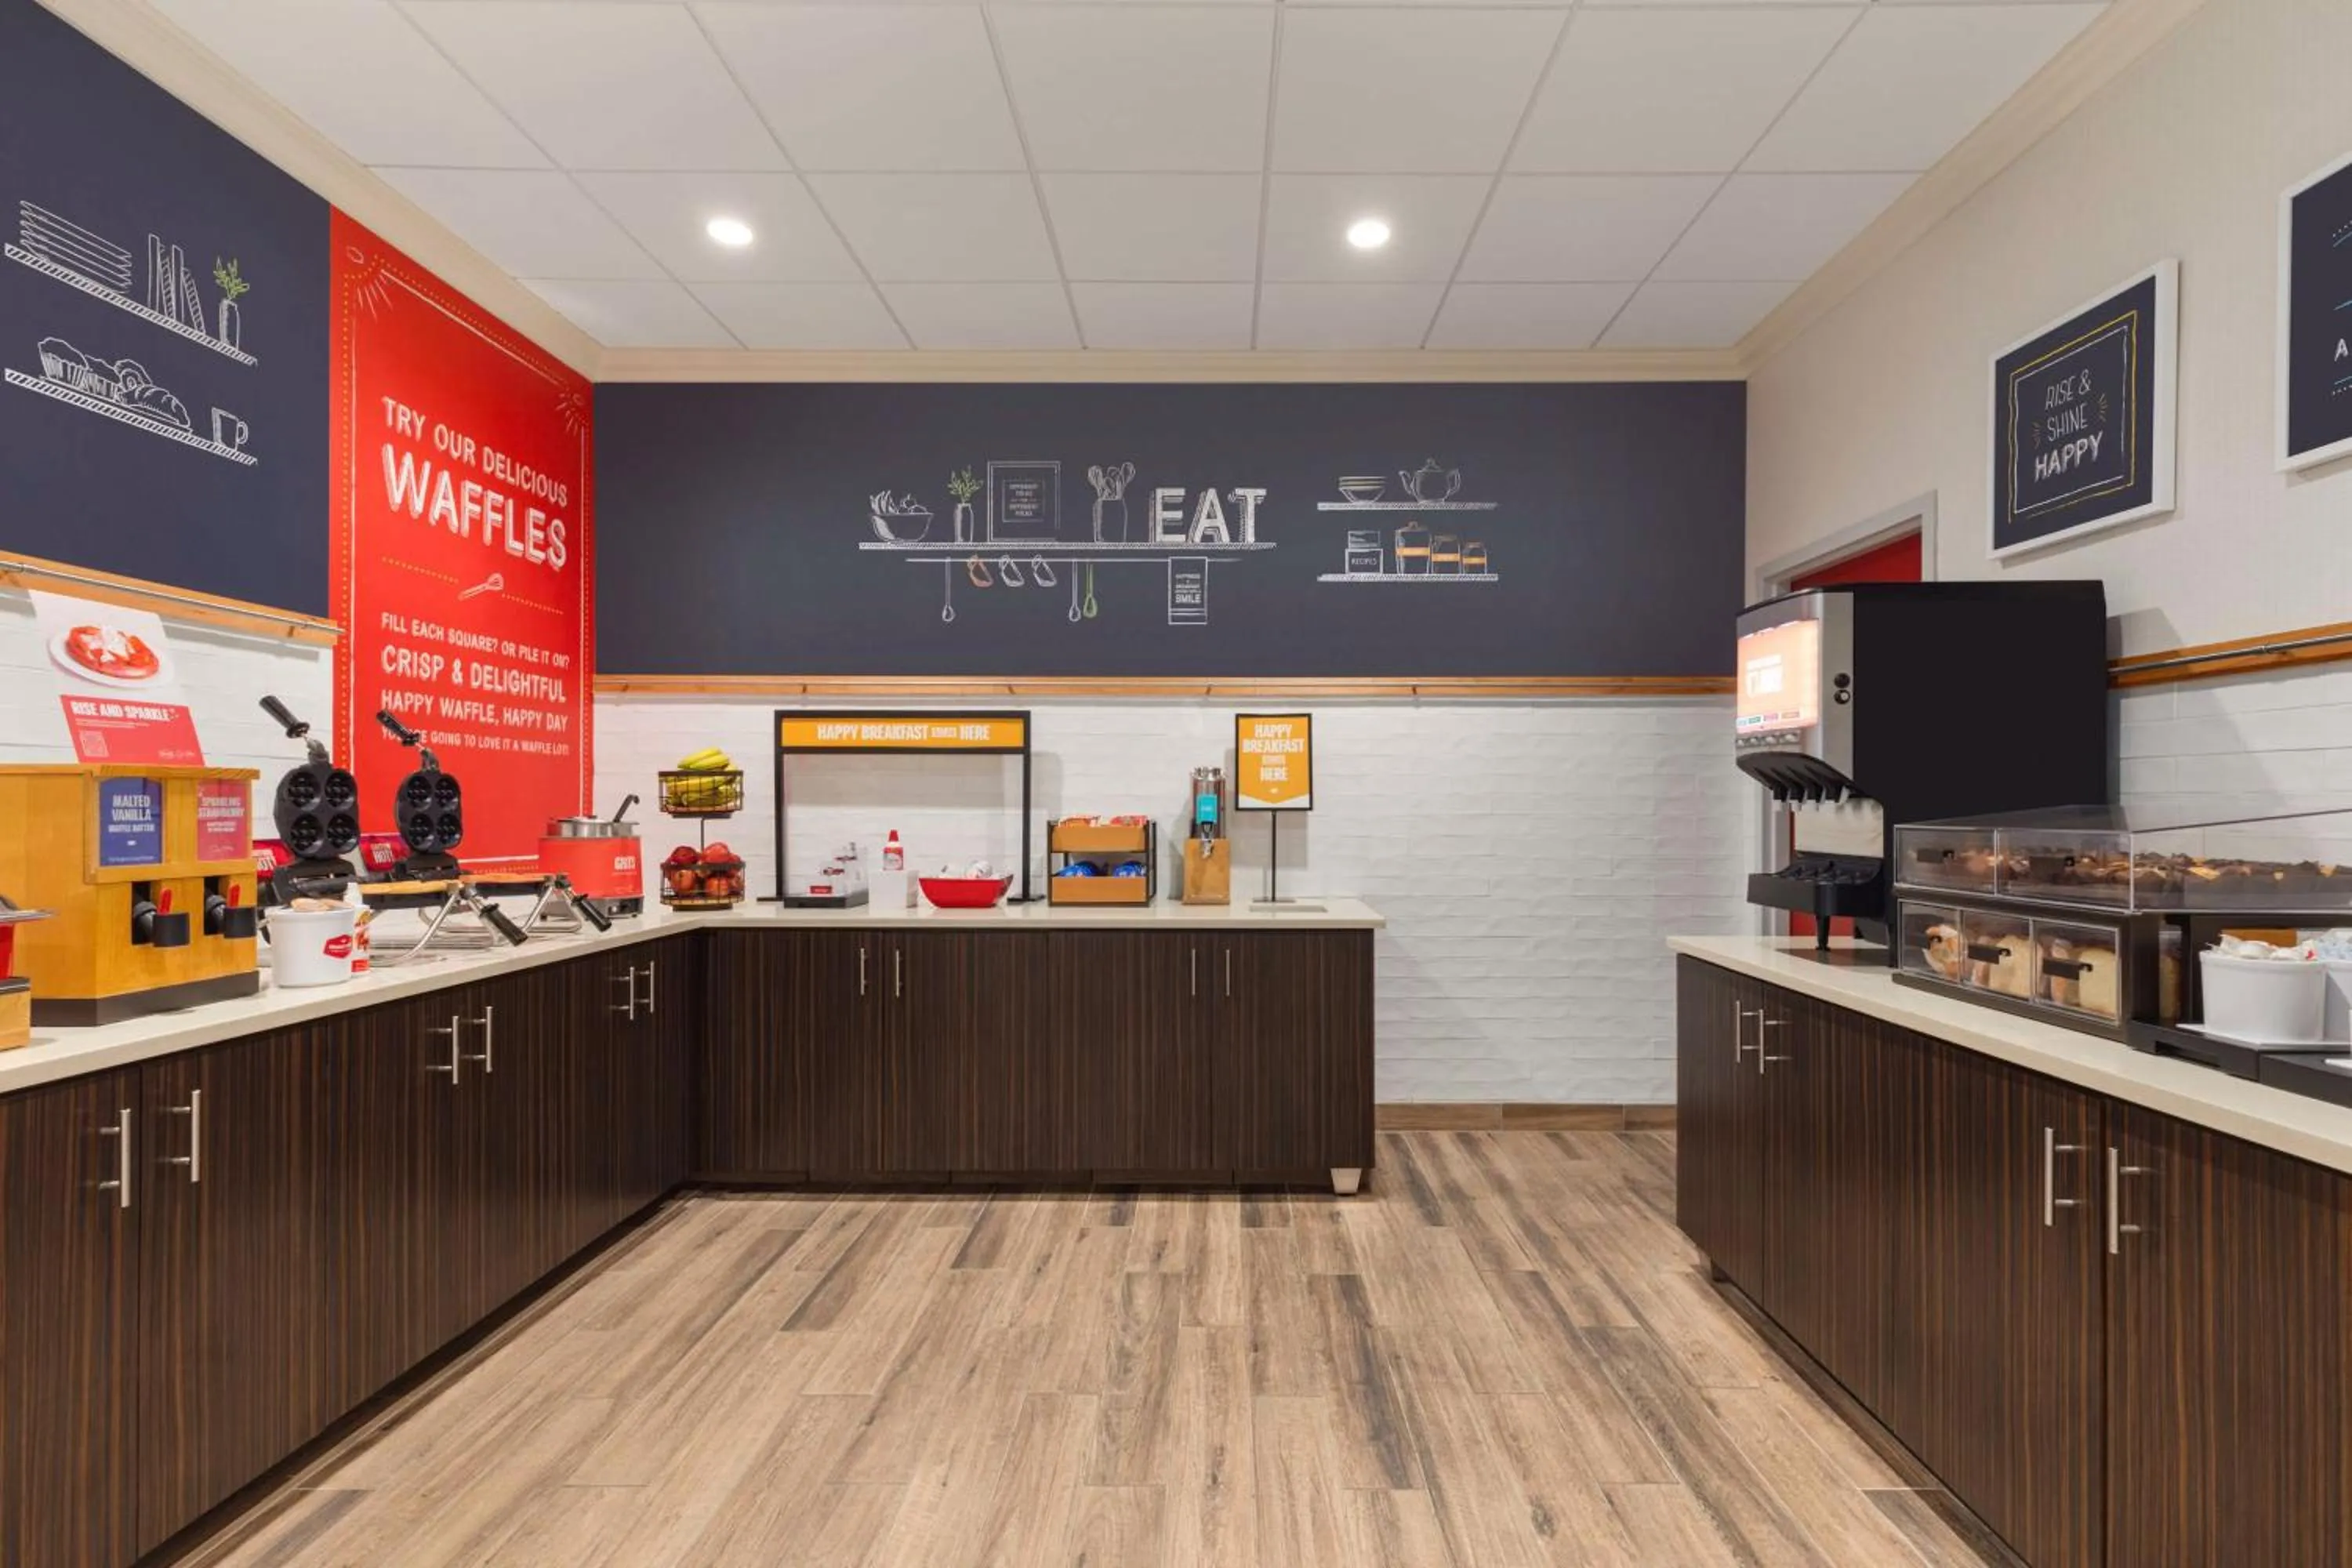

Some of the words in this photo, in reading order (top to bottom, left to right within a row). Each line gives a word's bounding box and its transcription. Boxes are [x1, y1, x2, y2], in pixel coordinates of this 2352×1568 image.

[2045, 376, 2076, 410] RISE
[2078, 368, 2092, 395] &
[2047, 402, 2089, 441] SHINE
[382, 396, 426, 442] TRY
[434, 423, 477, 467] OUR
[482, 446, 568, 508] DELICIOUS
[2034, 430, 2103, 483] HAPPY
[382, 442, 567, 572] WAFFLES
[1149, 488, 1267, 543] EAT
[1175, 593, 1201, 603] SMILE
[382, 612, 407, 633] FILL
[412, 619, 444, 641] EACH
[448, 628, 498, 653] SQUARE?
[501, 640, 516, 659] OR
[518, 644, 539, 663] PILE
[542, 650, 550, 666] IT
[382, 645, 445, 682] CRISP
[452, 658, 463, 685] &
[470, 662, 566, 703] DELIGHTFUL
[71, 701, 97, 715] RISE
[100, 703, 123, 717] AND
[382, 689, 434, 715] HAPPY
[439, 696, 500, 726] WAFFLE,
[503, 707, 543, 729] HAPPY
[546, 713, 568, 732] DAY
[432, 730, 461, 746] GOING
[464, 733, 476, 746] TO
[478, 736, 501, 750] LOVE
[513, 739, 520, 752] A
[818, 724, 858, 740] HAPPY
[862, 724, 928, 740] BREAKFAST
[960, 725, 989, 740] HERE
[1242, 739, 1305, 753] BREAKFAST
[1254, 724, 1292, 738] HAPPY
[111, 808, 151, 822] VANILLA
[112, 794, 151, 808] MALTED
